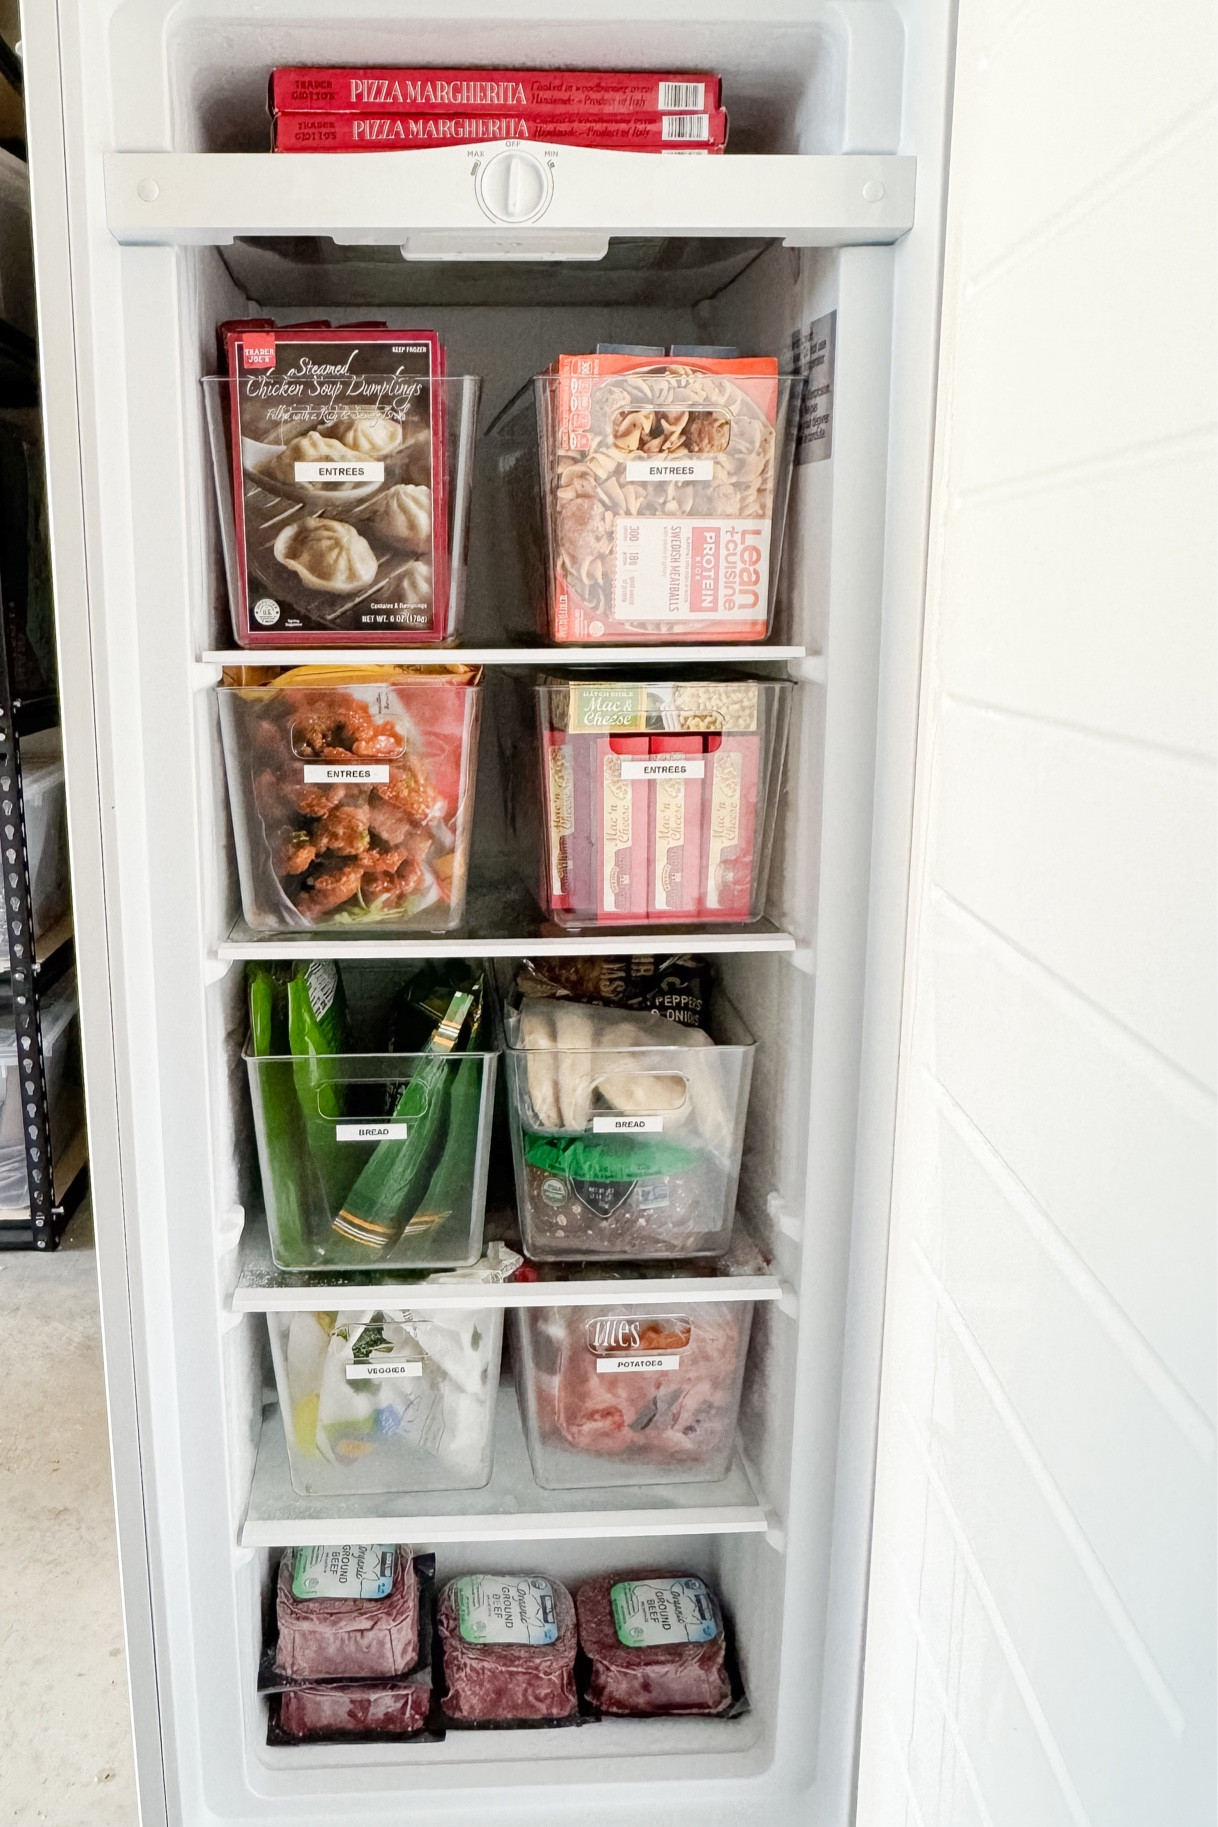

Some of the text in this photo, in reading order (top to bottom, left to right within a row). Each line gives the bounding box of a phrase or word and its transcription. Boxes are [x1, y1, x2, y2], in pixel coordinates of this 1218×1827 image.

[350, 79, 528, 104] PIZZA MARGHERITA
[352, 118, 529, 140] PIZZA MARGHERITA
[295, 350, 359, 377] Steamed
[246, 366, 423, 411] Chicken Soup Dumplings
[318, 467, 365, 476] ENTREES
[649, 466, 694, 475] ENTREES
[629, 525, 640, 542] 300
[668, 525, 682, 612] SWEDISH MEATBALLS
[701, 531, 716, 607] PROTEIN
[738, 528, 762, 610] Lean
[361, 615, 375, 623] NET
[584, 696, 632, 712] Mac &
[584, 711, 632, 726] Cheese
[326, 770, 371, 778] ENTREES
[643, 765, 687, 774] ENTREES
[606, 816, 618, 847] Mac
[619, 804, 630, 843] Cheese
[658, 815, 670, 845] Mac
[671, 802, 682, 841] Cheese
[655, 994, 703, 1010] PEPPERS
[358, 1128, 389, 1136] BREAD
[615, 1120, 646, 1128] BREAD
[367, 1366, 405, 1375] VEGGIES
[617, 1360, 663, 1368] POTATOES
[329, 1551, 341, 1575] BEEF
[338, 1545, 351, 1584] GROUND
[492, 1593, 503, 1619] BEEF
[501, 1586, 514, 1629] GROUND
[646, 1599, 660, 1624] BEEF
[655, 1590, 672, 1631] GROUND
